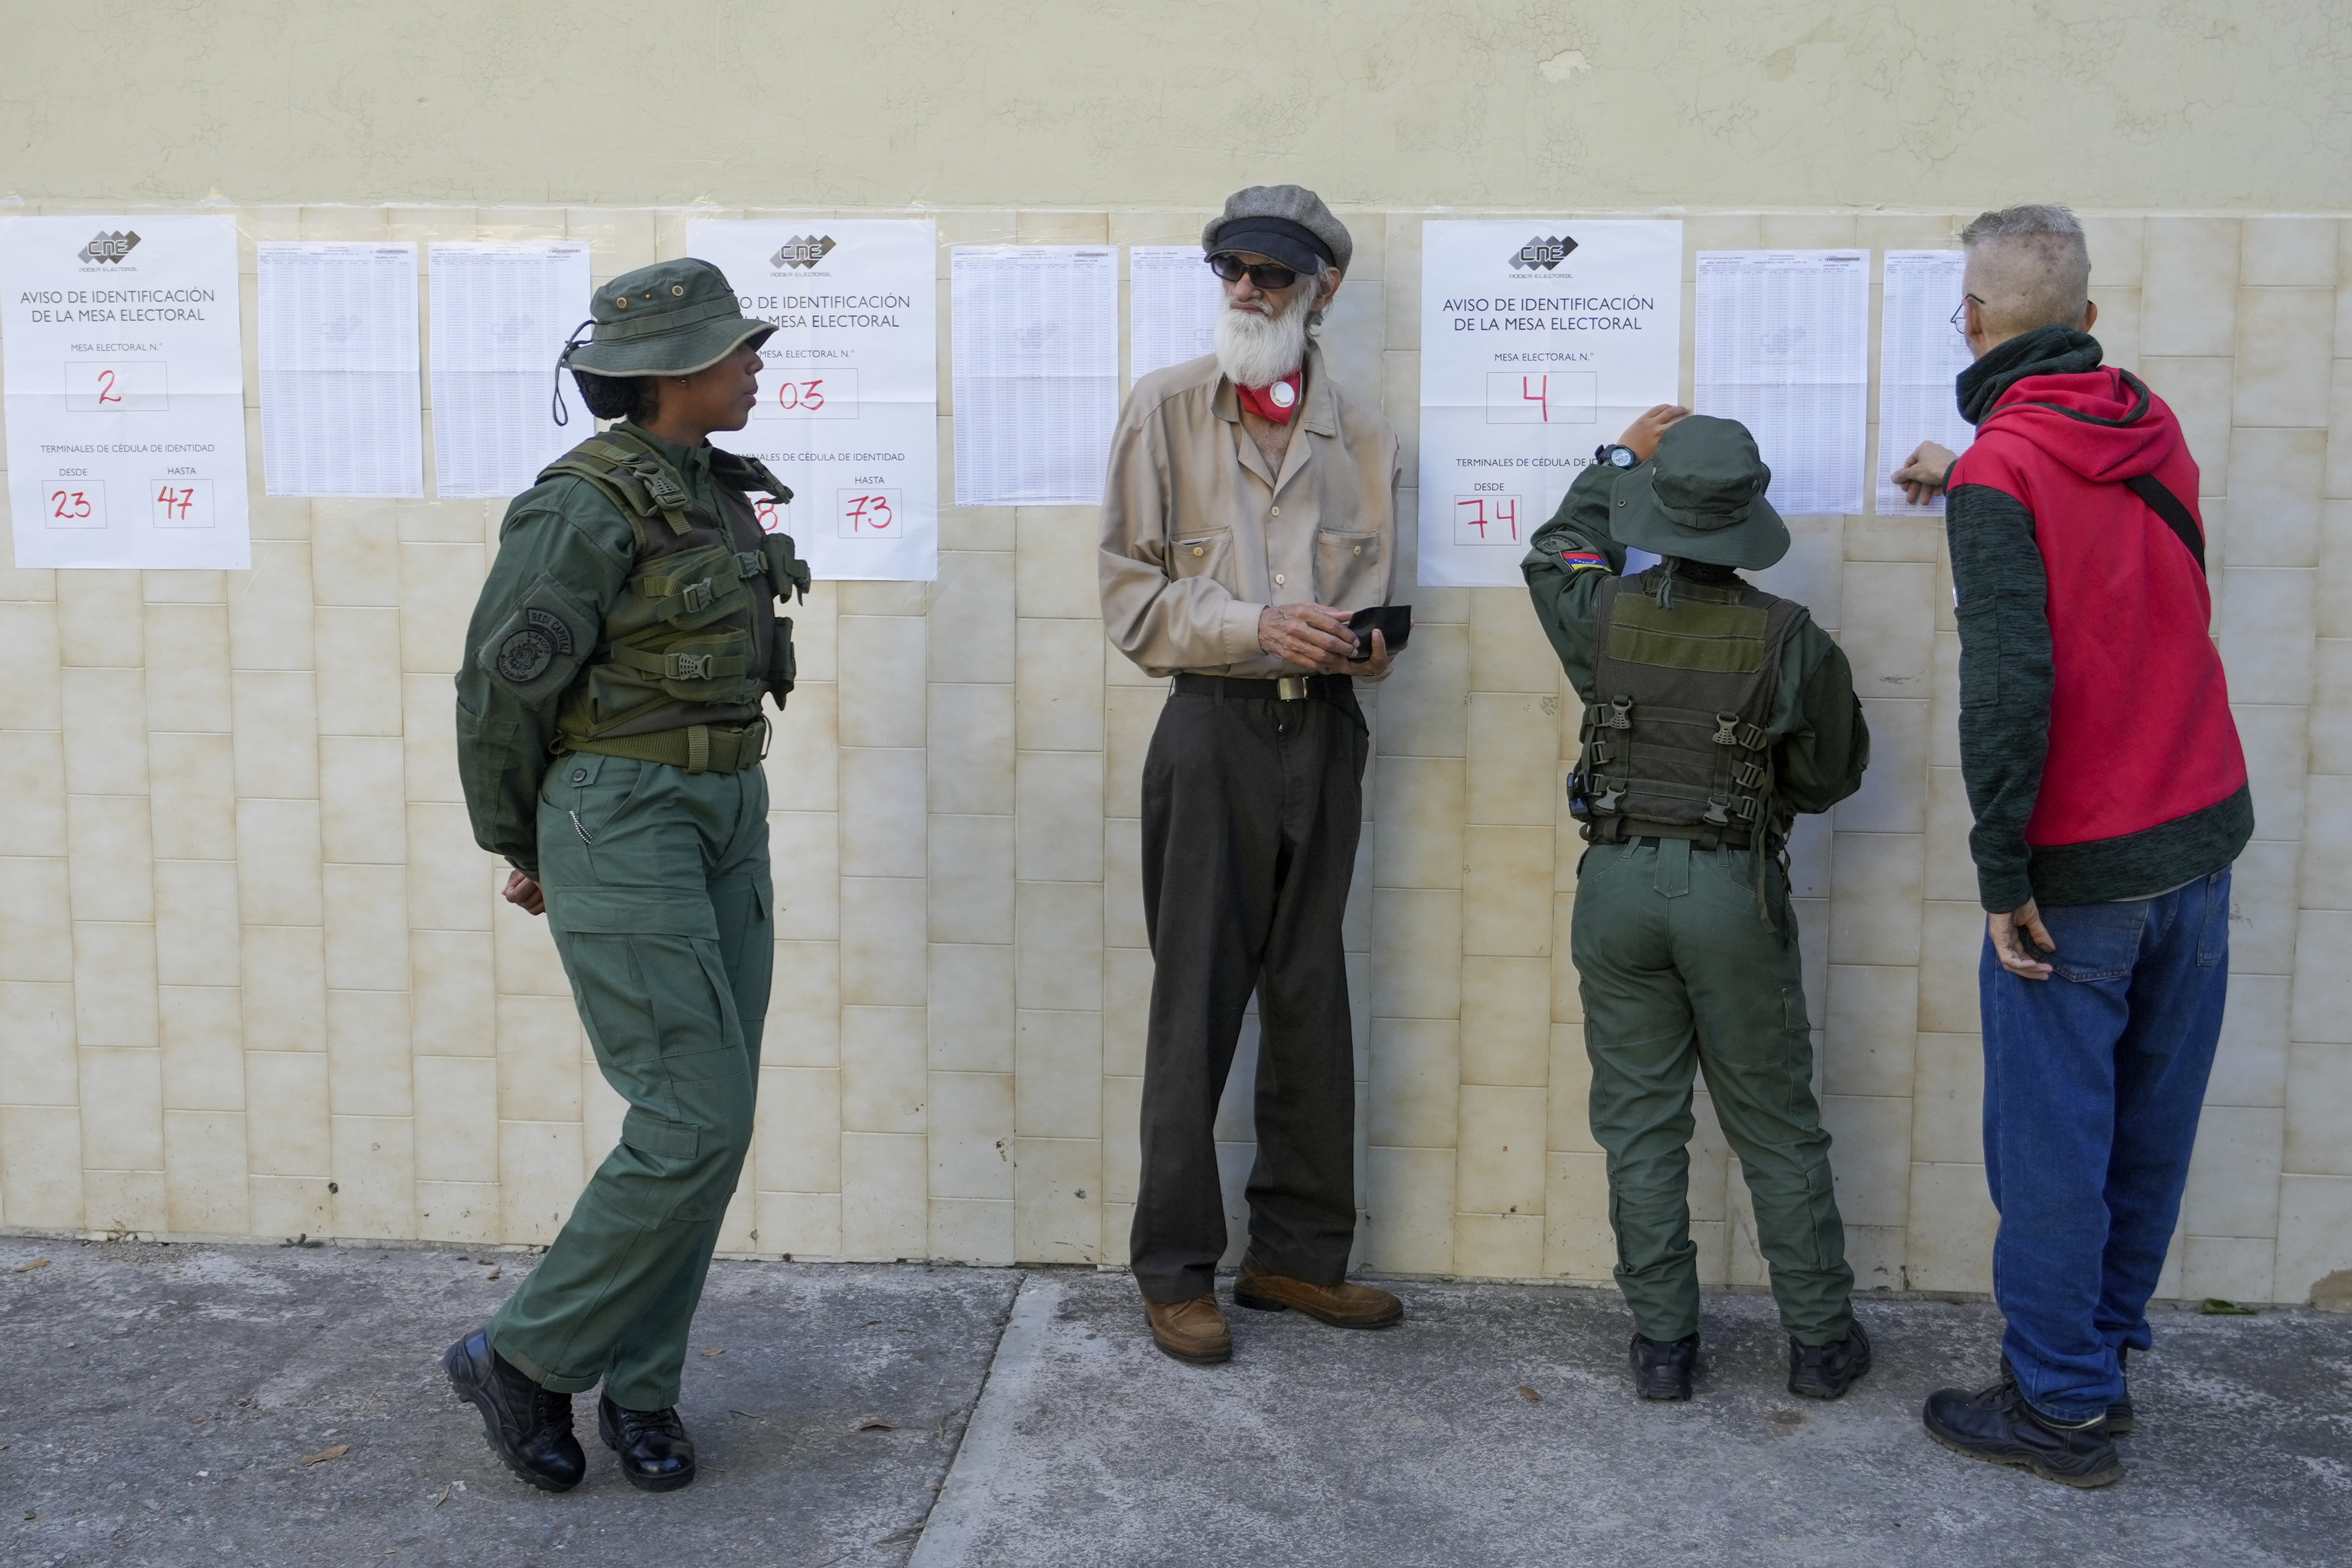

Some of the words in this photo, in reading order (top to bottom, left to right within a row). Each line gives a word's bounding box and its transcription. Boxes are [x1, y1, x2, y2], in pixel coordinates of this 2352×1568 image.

[87, 240, 129, 256] CNE
[780, 244, 823, 261] CNE
[1521, 246, 1563, 263] CNE
[21, 292, 62, 303] AVISO
[68, 291, 87, 303] DE
[92, 286, 214, 302] IDENTIFICACIÓN
[758, 297, 777, 309] DE
[783, 292, 910, 309] IDENTIFICACIÓN
[1443, 299, 1488, 311] AVISO
[1495, 299, 1515, 311] DE
[1521, 295, 1653, 311] IDENTIFICACIÓN
[32, 310, 51, 322] DE
[56, 310, 74, 322] LA
[79, 310, 116, 322] MESA
[121, 309, 204, 321] ELECTORAL
[769, 315, 807, 328] MESA
[812, 315, 899, 327] ELECTORAL
[1455, 318, 1475, 331] DE
[1481, 318, 1499, 330] LA
[1505, 318, 1545, 330] MESA
[1551, 318, 1642, 330] ELECTORAL
[97, 370, 121, 404] 2
[779, 380, 824, 410] 03
[1523, 374, 1547, 422] 4
[41, 445, 93, 453] TERMINALES
[112, 443, 148, 452] CÉDULA
[798, 452, 835, 461] CÉDULA
[1532, 457, 1570, 466] CÉDULA
[51, 491, 90, 518] 23
[157, 486, 194, 521] 47
[846, 495, 892, 532] 73
[1457, 498, 1517, 541] 74
[532, 612, 551, 624] REDI
[552, 622, 570, 652] CAPITAL
